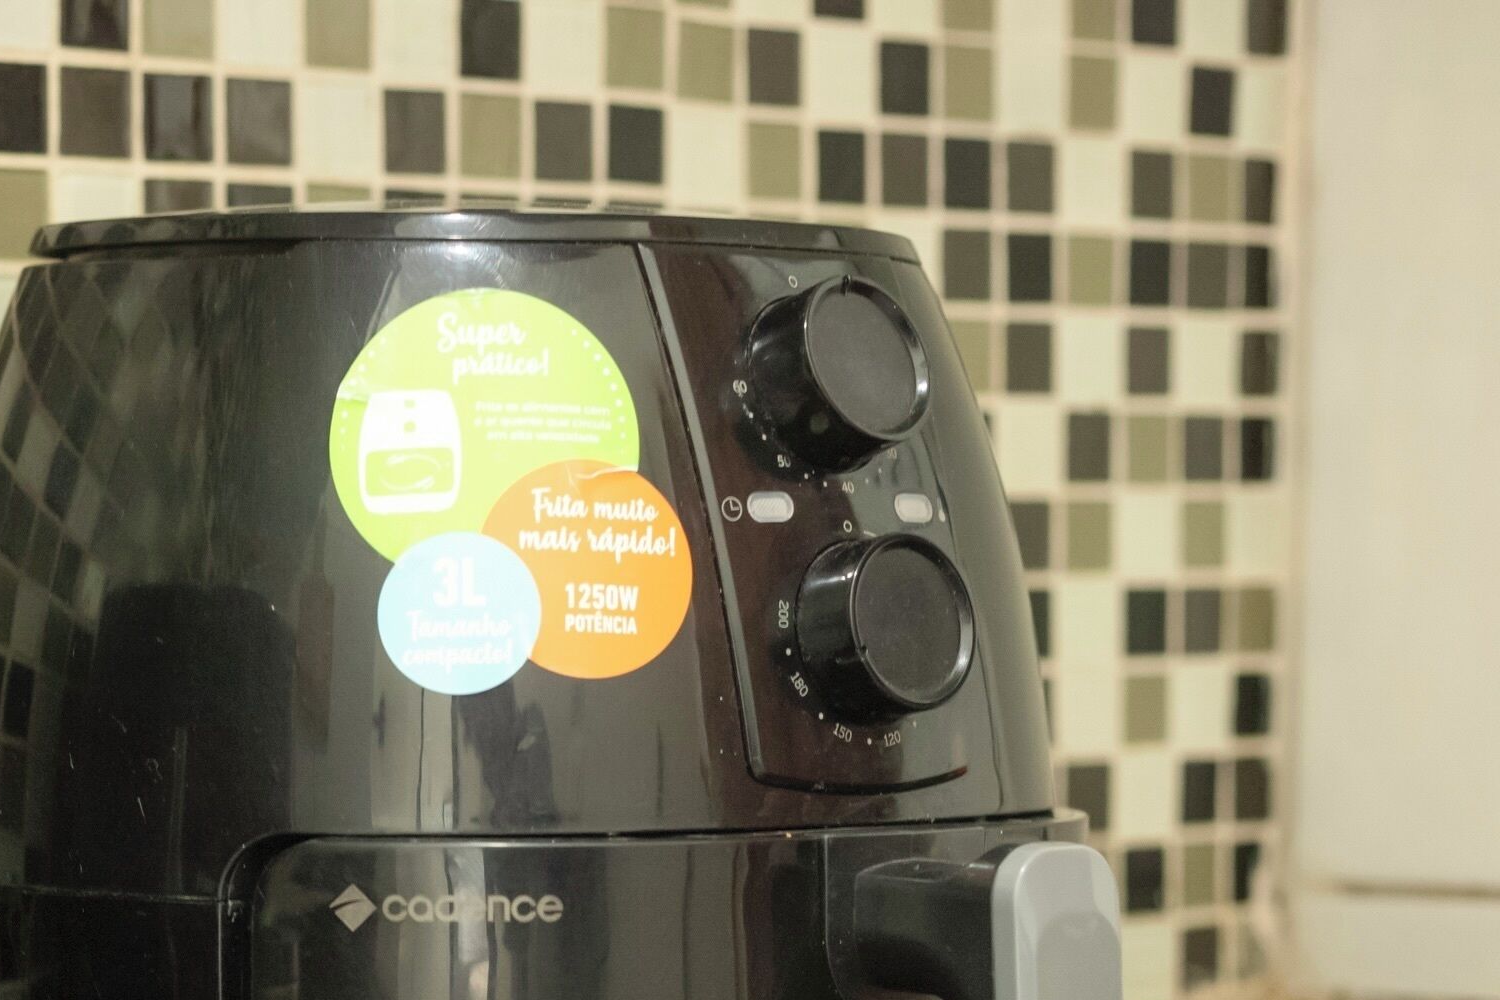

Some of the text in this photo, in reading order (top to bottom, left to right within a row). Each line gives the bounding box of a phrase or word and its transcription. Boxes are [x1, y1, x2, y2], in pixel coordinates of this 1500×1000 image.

[436, 311, 527, 357] Super
[452, 347, 549, 386] prático!
[732, 379, 748, 394] 60
[777, 453, 791, 468] 50
[842, 481, 855, 494] 40
[531, 486, 659, 524] Frita muito
[518, 525, 676, 565] mais rápido!
[431, 556, 488, 608] 3L
[565, 582, 639, 611] 1250W
[404, 609, 512, 641] Tamanho
[565, 610, 637, 635] POTÊNCIA
[778, 599, 789, 629] 200
[790, 671, 809, 697] 180
[832, 722, 853, 743] 150
[883, 730, 901, 748] 120
[382, 893, 564, 924] cadnce
